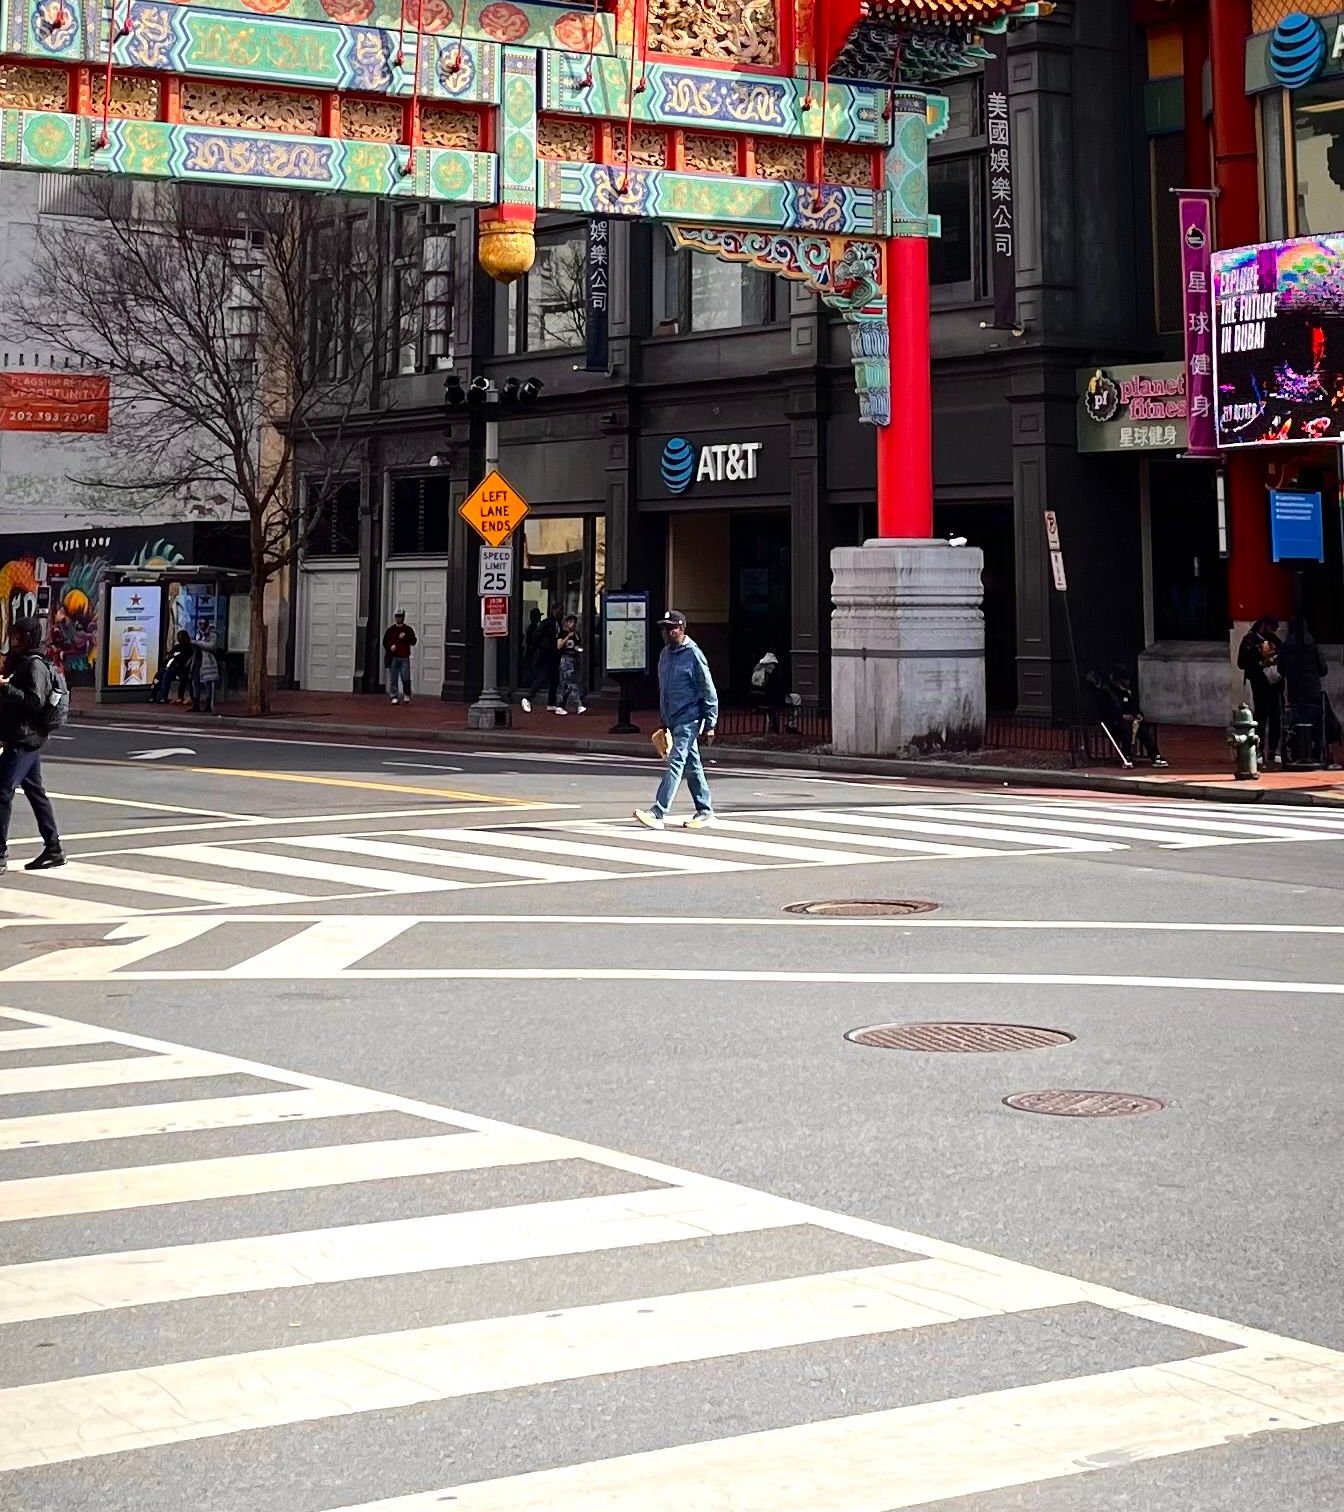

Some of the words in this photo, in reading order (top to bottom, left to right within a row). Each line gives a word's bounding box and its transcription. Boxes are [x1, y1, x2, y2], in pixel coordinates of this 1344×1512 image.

[1220, 296, 1238, 325] THE
[1239, 291, 1278, 322] FUTURE
[1188, 271, 1212, 418] 星球健身
[1220, 326, 1233, 355] IN
[1233, 321, 1266, 353] DUBAI
[10, 376, 62, 387] FLAGSHIP
[1094, 390, 1109, 410] pf
[1119, 373, 1186, 405] planet
[1128, 397, 1188, 421] fitnes
[1119, 425, 1177, 448] 星球健身
[696, 442, 763, 482] AT&T
[482, 491, 507, 503] LEFT
[480, 505, 510, 518] LANE
[481, 519, 511, 532] ENDS
[483, 551, 511, 561] SPEED
[485, 561, 508, 571] LIMIT
[483, 572, 508, 591] 25
